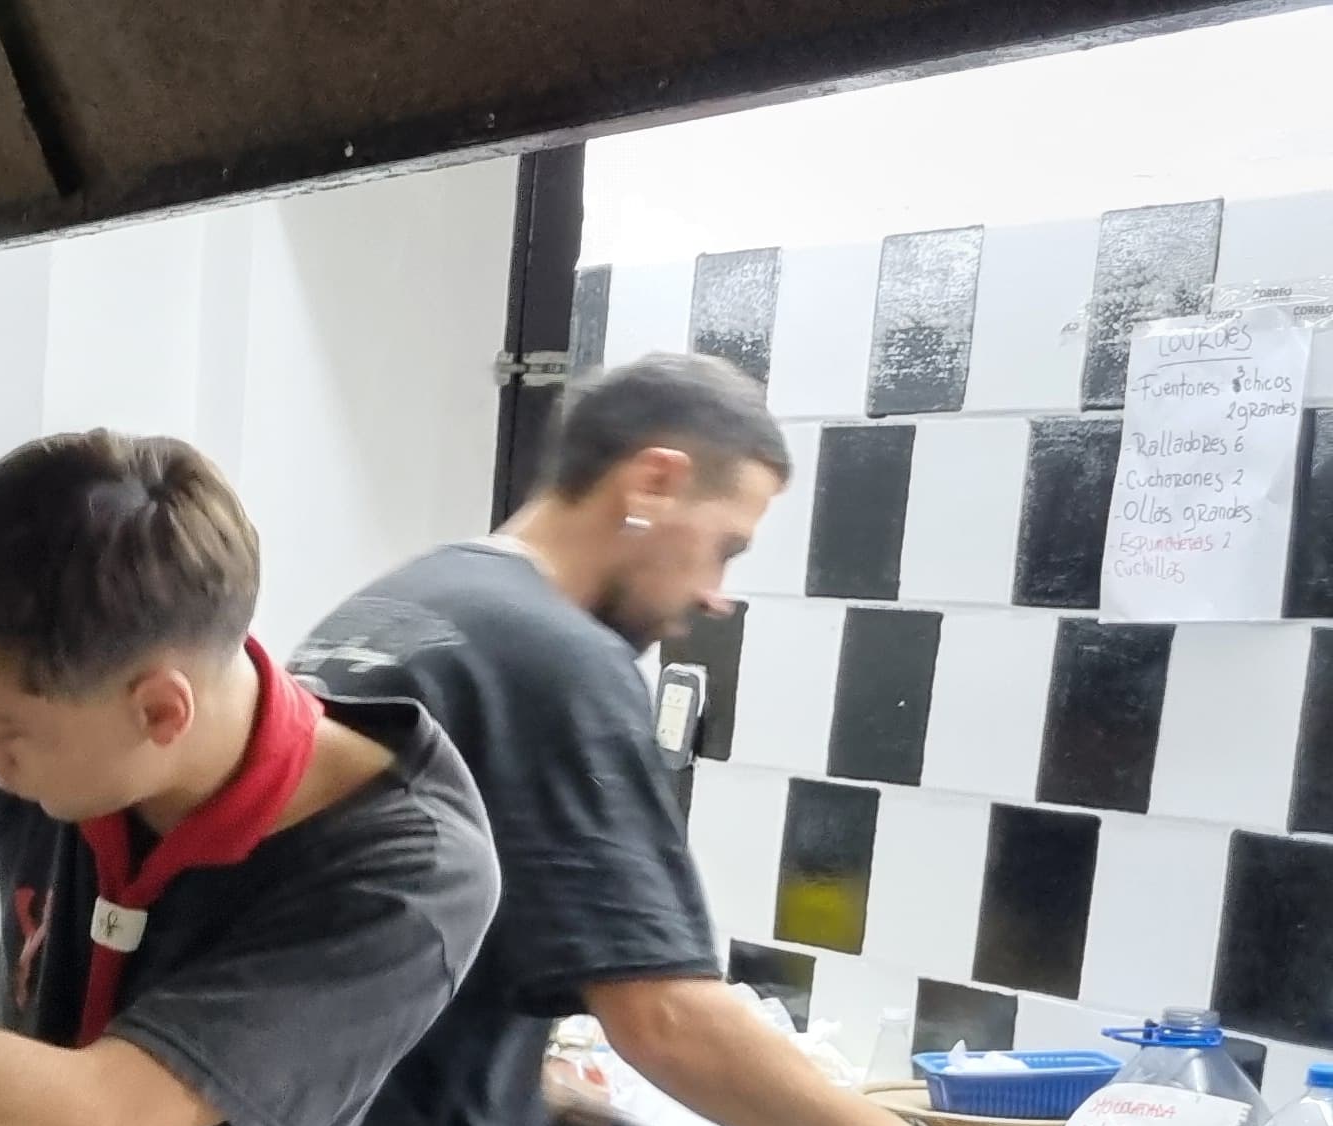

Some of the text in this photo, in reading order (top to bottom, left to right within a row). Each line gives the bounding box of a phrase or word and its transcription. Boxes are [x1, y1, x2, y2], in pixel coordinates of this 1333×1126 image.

[1234, 435, 1245, 453] 6
[1231, 468, 1244, 485] 2
[1221, 532, 1232, 549] 2
